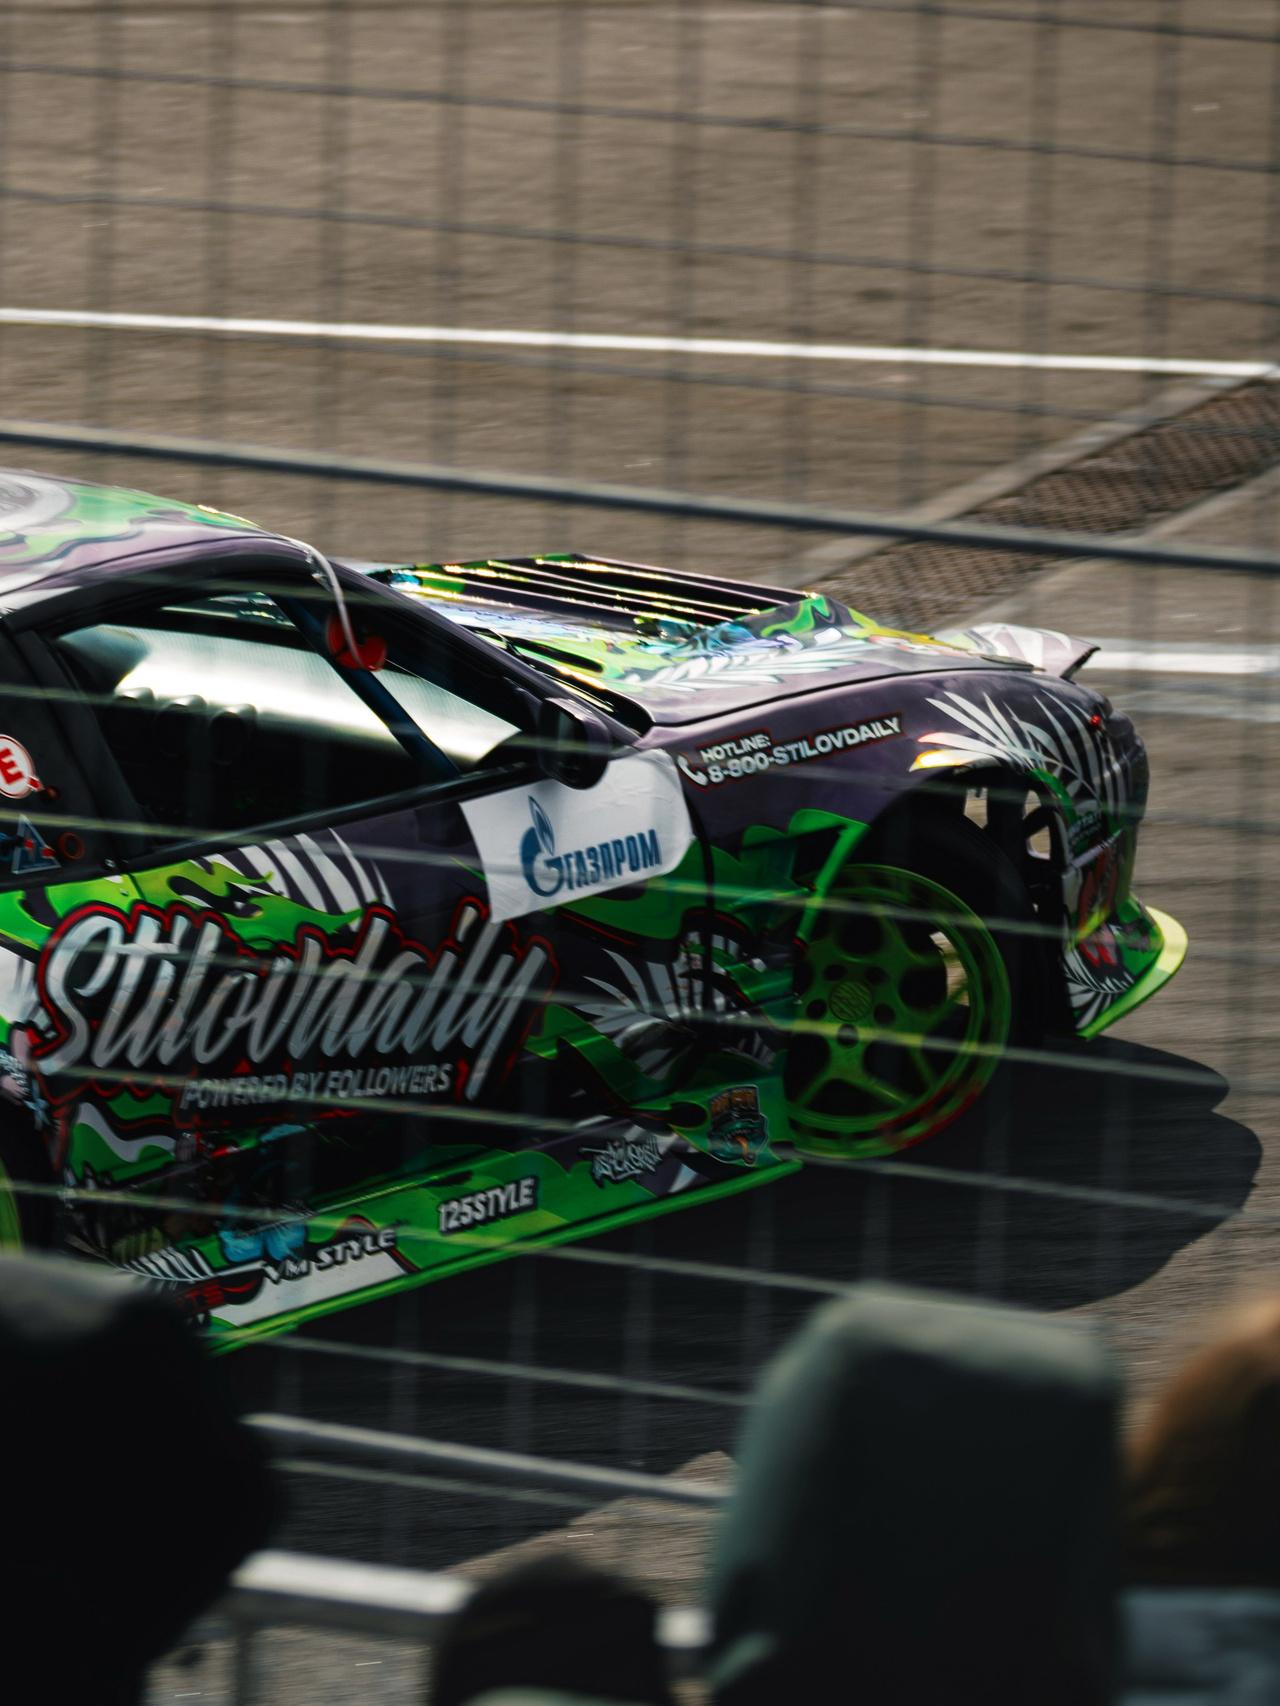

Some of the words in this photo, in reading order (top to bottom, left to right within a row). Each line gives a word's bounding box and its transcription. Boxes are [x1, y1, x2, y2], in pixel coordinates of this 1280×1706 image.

[562, 829, 663, 891] ГАЗПРОМ
[33, 904, 552, 1101] Stilovdaily
[179, 1074, 288, 1110] POWERED
[290, 1071, 323, 1100] BY
[324, 1063, 453, 1099] FOLLOWERS
[317, 1229, 395, 1268] STYLE
